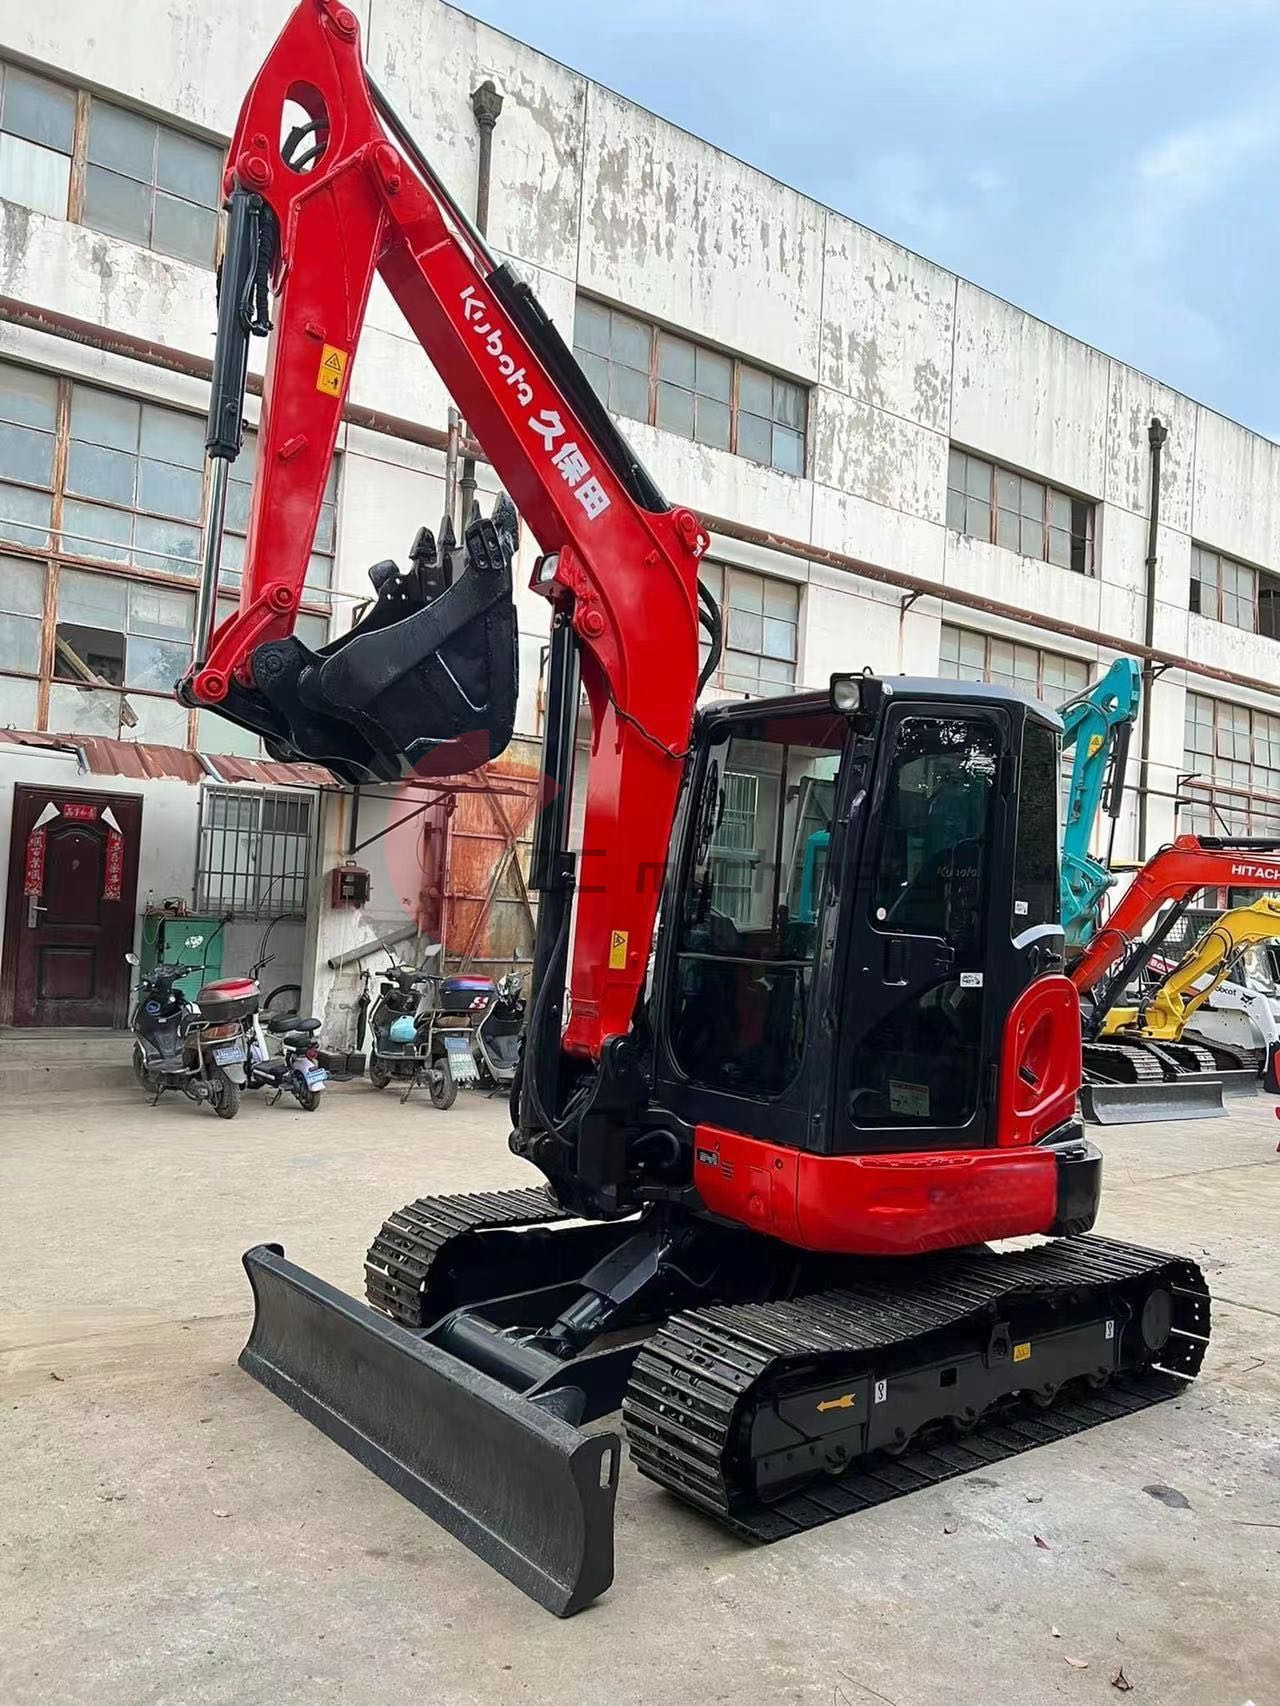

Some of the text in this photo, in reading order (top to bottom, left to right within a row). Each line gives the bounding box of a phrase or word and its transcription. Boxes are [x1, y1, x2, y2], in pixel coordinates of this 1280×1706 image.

[459, 285, 612, 520] Kubota 久保田
